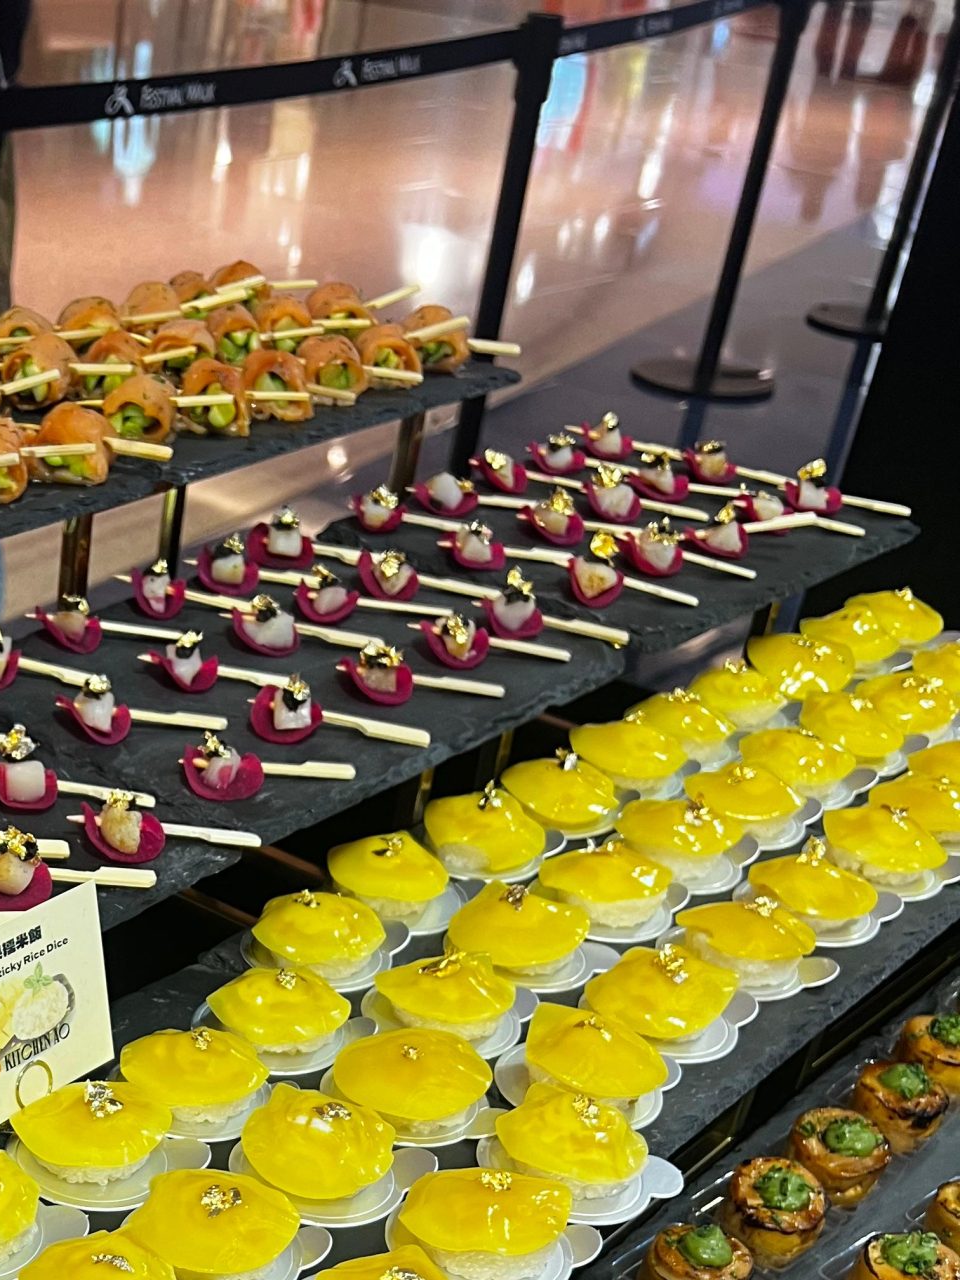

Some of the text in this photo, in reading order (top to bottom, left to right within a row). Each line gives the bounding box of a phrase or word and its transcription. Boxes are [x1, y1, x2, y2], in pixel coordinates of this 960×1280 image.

[23, 948, 46, 965] Rice
[46, 937, 69, 954] Dice
[4, 1022, 70, 1072] KITCHEN AO
